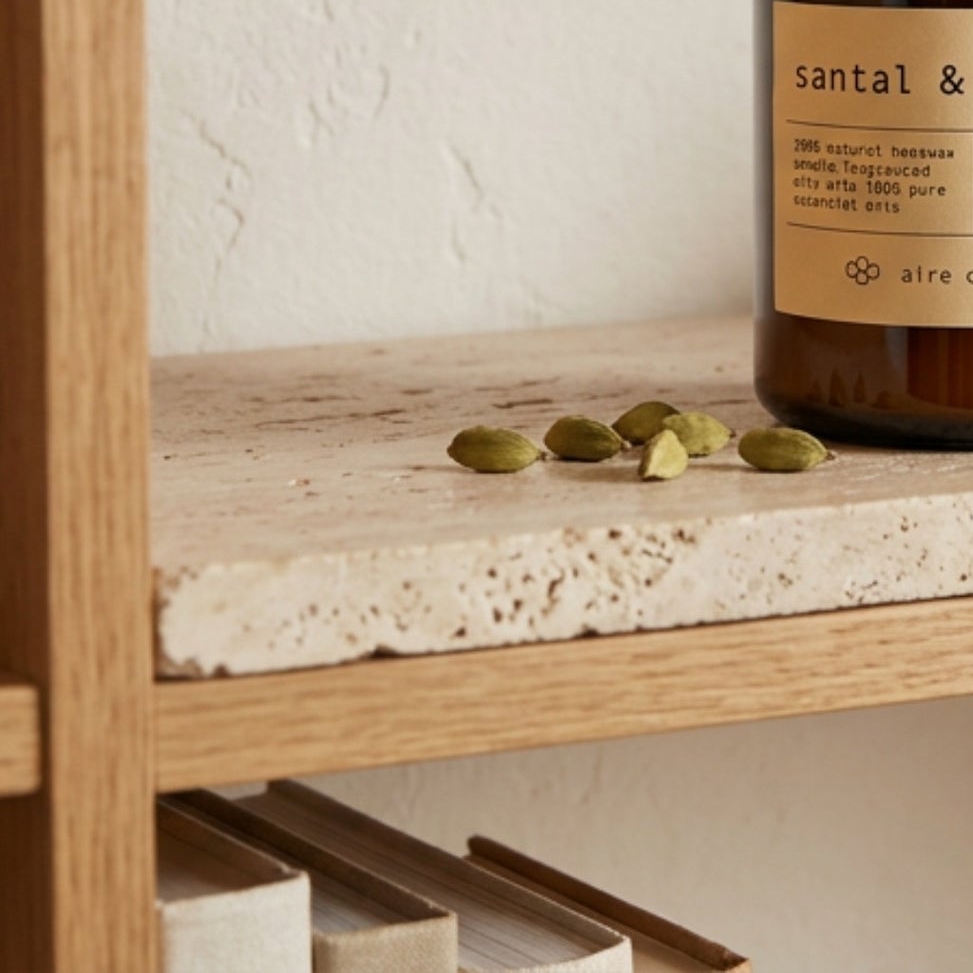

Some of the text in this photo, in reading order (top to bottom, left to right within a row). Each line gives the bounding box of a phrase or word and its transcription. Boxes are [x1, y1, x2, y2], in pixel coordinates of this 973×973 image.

[796, 64, 910, 94] santal
[940, 65, 965, 94] &
[909, 184, 946, 198] pure
[901, 265, 951, 284] aire
